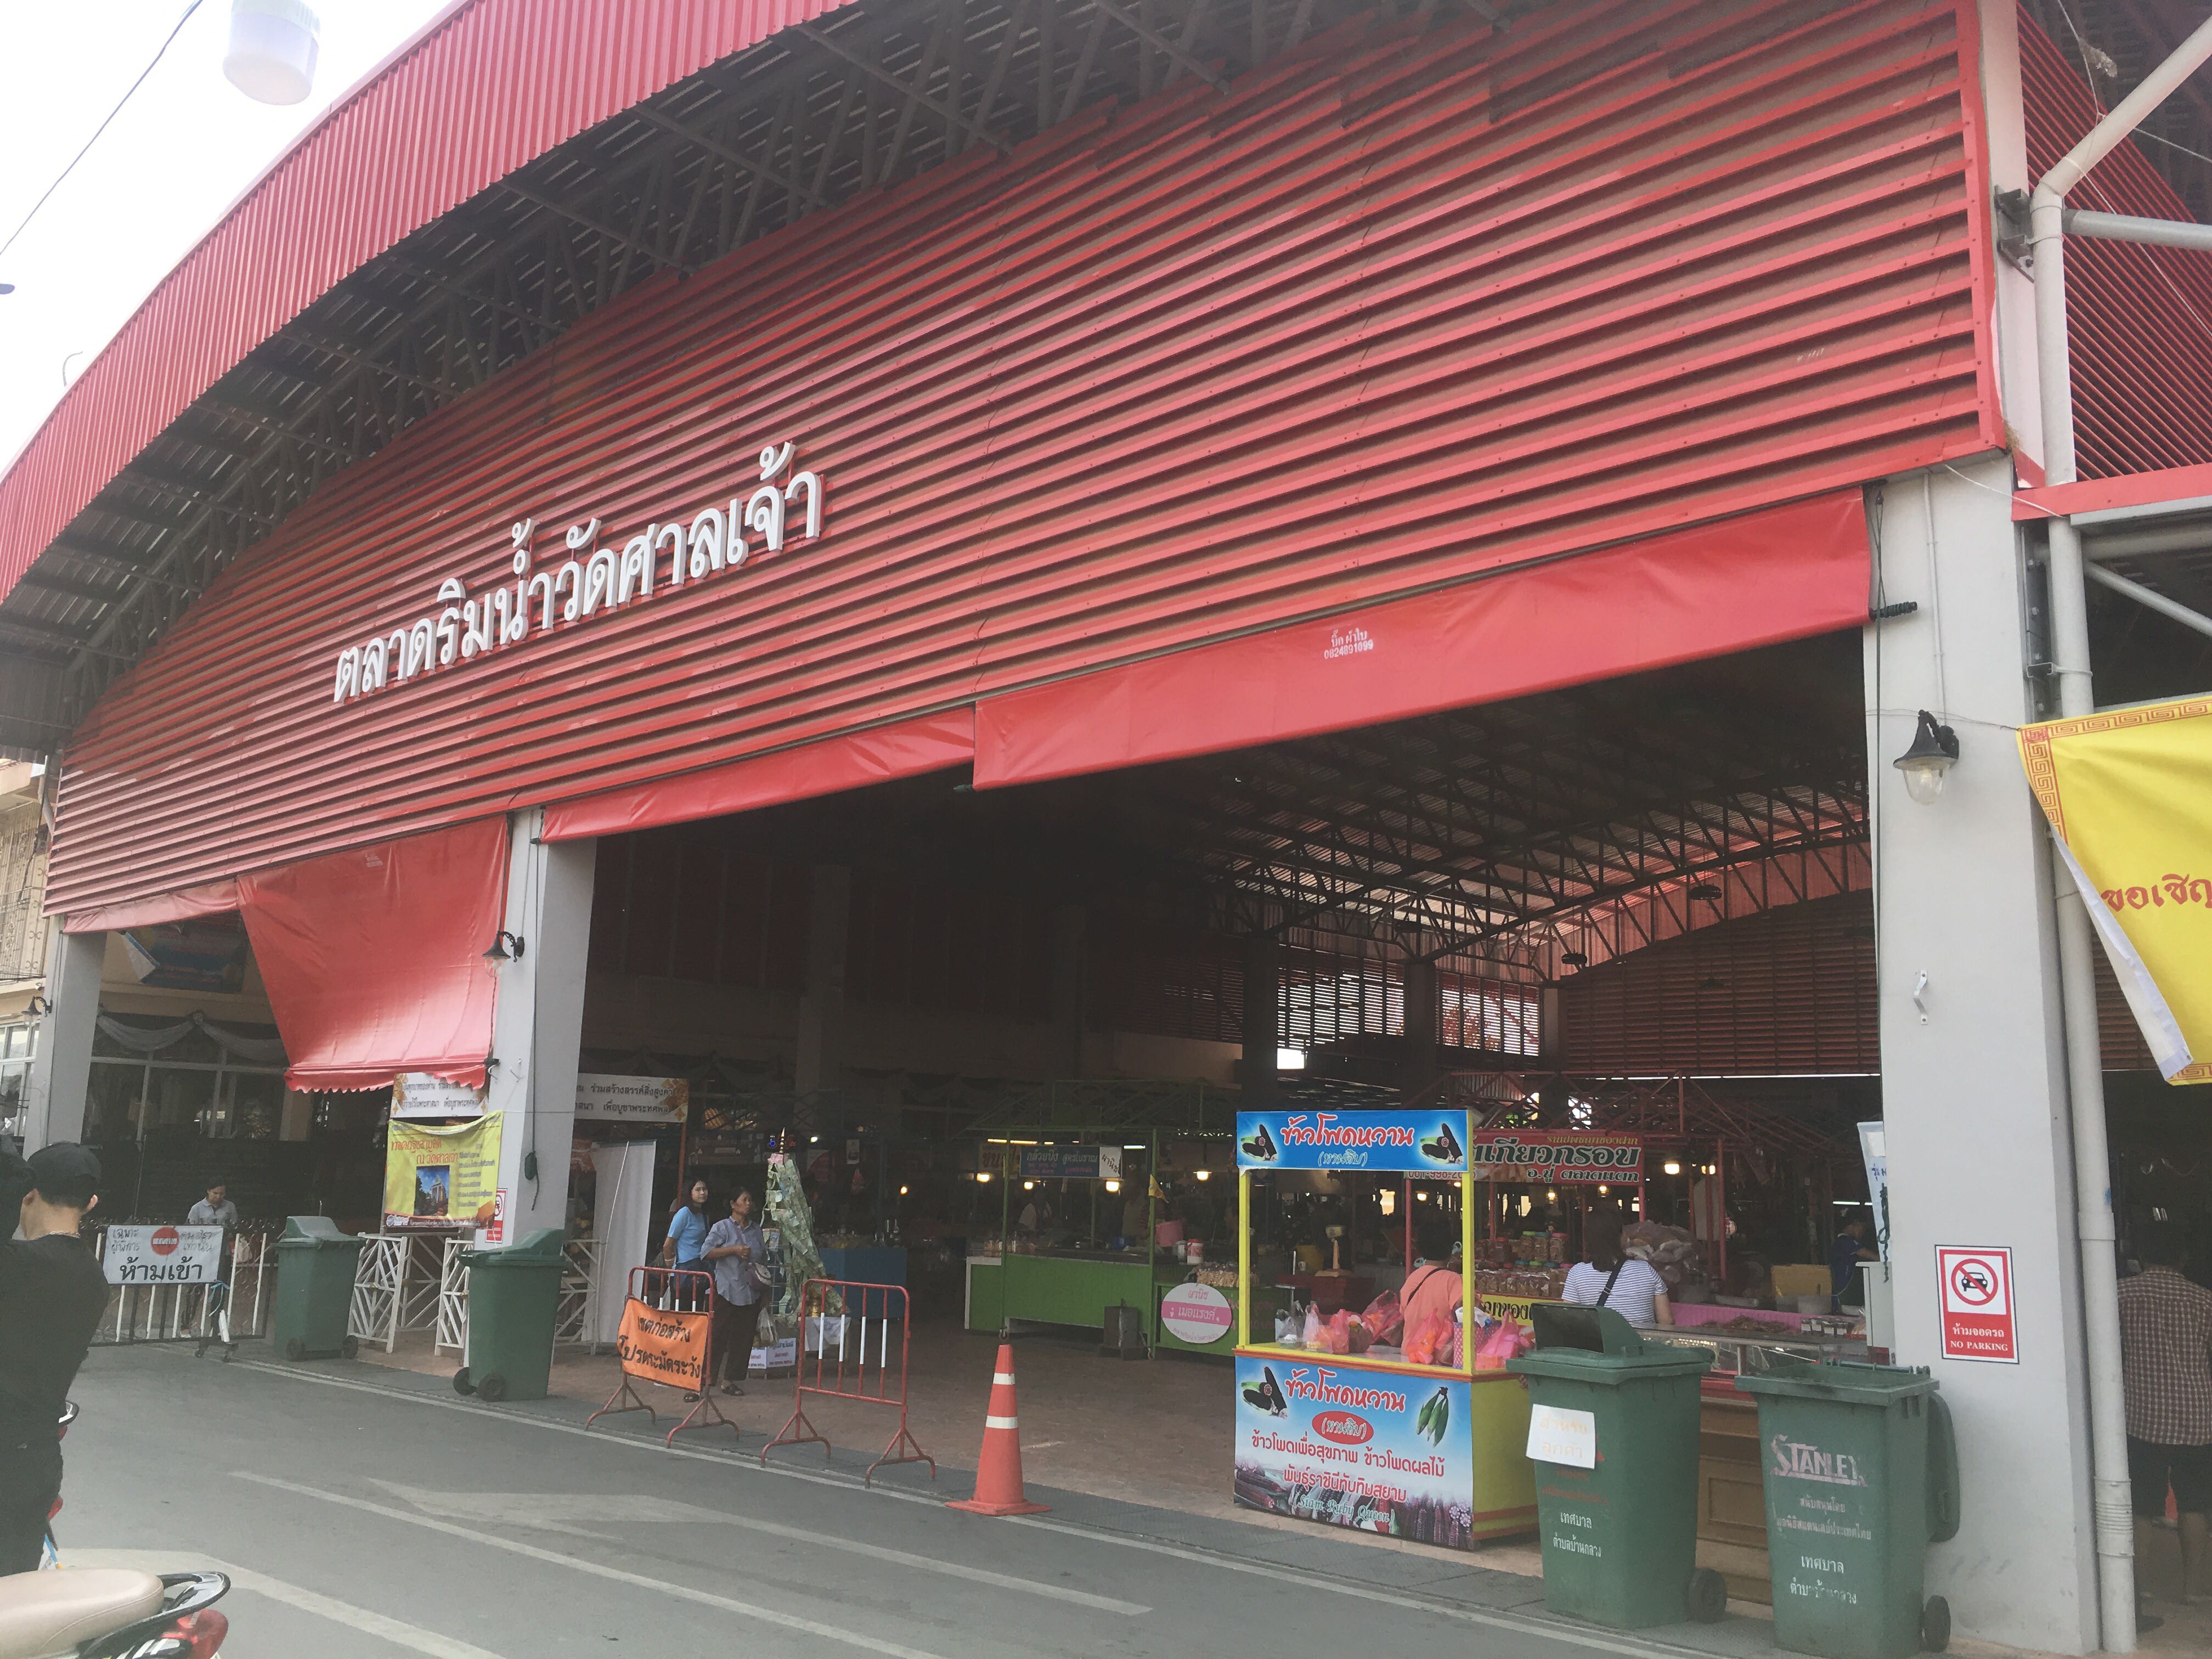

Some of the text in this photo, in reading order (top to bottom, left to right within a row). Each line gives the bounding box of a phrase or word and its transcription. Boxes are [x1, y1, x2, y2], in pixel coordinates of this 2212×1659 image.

[334, 441, 823, 703] ตลาดริมน้ำวัดศาลเจ้า
[1280, 1113, 1415, 1148] ข้าวโพดหวาน
[119, 1256, 203, 1281] ห้ามเข้า
[637, 1316, 691, 1343] เขตก่อสร้าง
[1953, 1322, 2005, 1338] ห้ามจอดรถ
[1950, 1340, 2008, 1351] NO PARKING
[1284, 1368, 1407, 1412] ข้าวโพดหวาน
[1251, 1429, 1445, 1478] ข้าวโพดเพื่อสุขภาพ ข้าวโพดผลไม้
[1770, 1434, 1866, 1487] STANLEY
[1283, 1464, 1407, 1503] พันธุ์ราชินีทับทิมสยาม
[1328, 1498, 1355, 1520] Ruby
[1560, 1511, 1592, 1529] เทศบาล
[1801, 1555, 1844, 1574] เทศบาล
